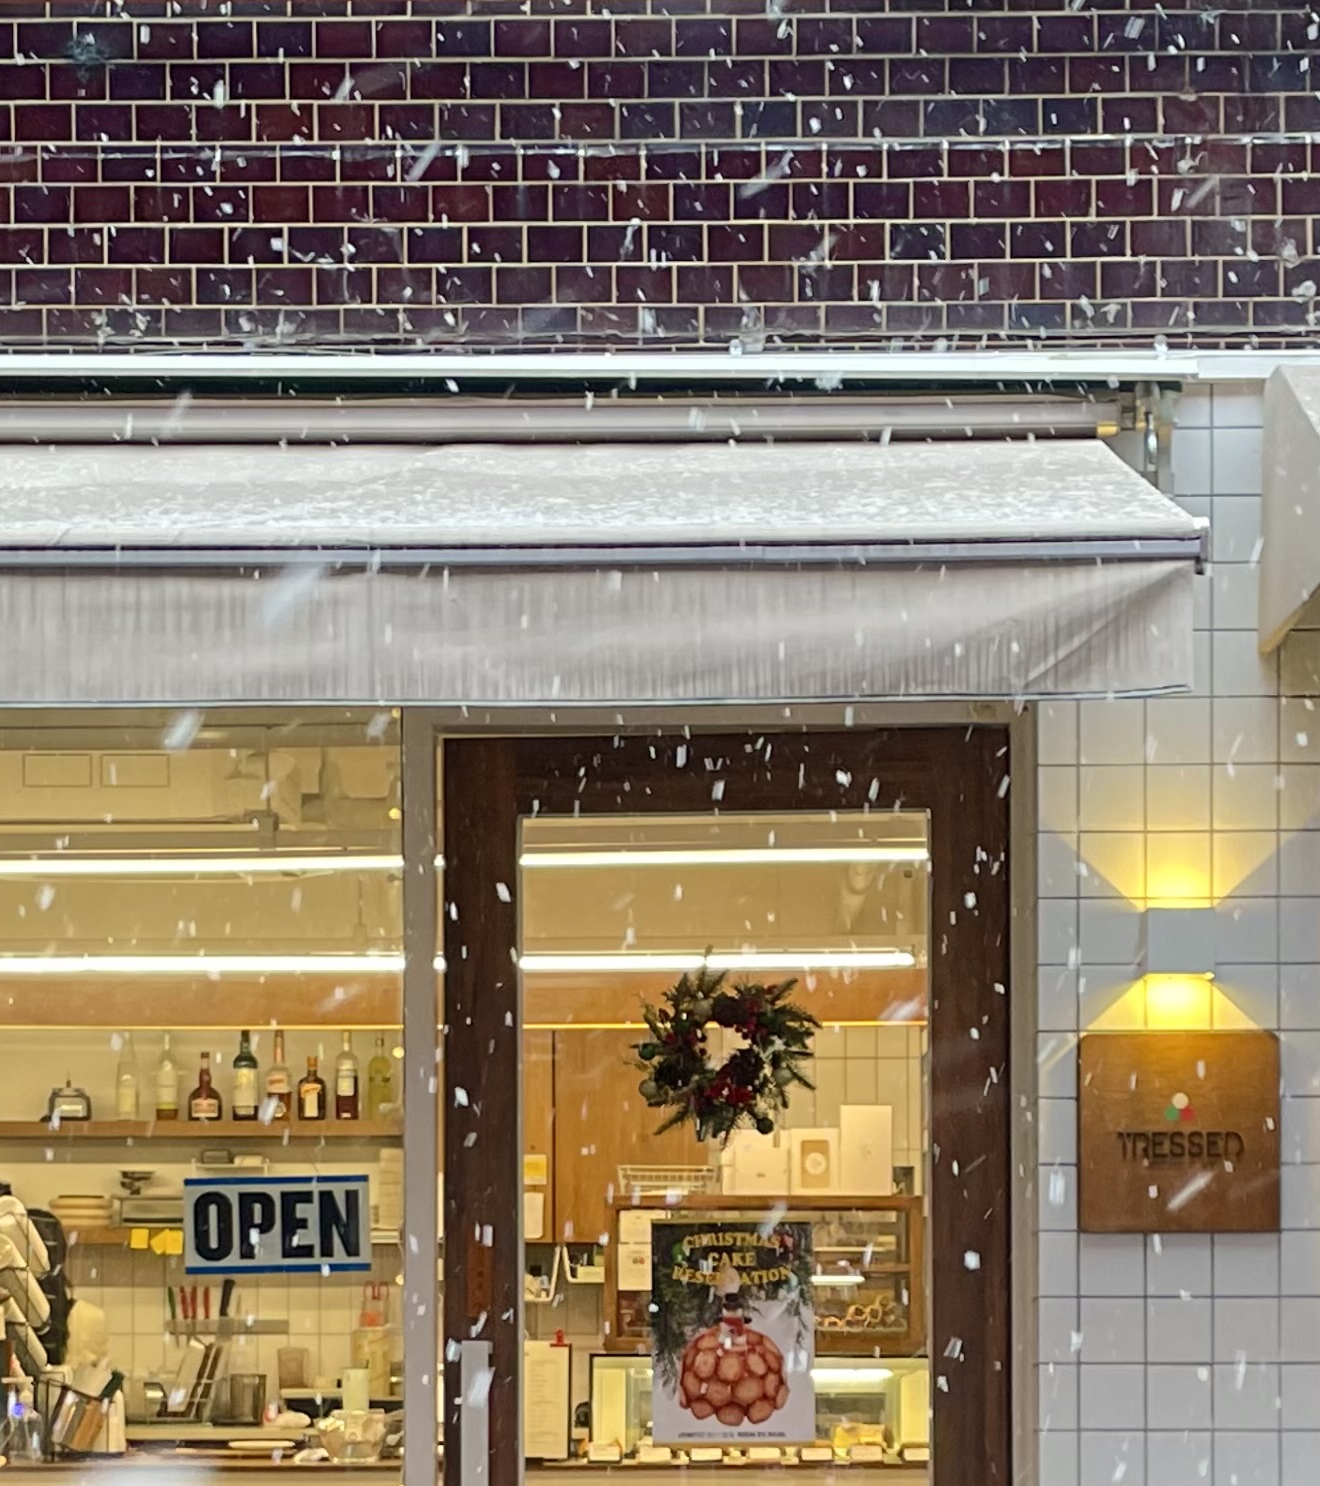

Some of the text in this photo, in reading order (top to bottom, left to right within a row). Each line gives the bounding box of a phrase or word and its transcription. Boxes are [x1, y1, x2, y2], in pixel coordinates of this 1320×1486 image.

[1116, 1131, 1245, 1160] TRESSED
[193, 1189, 361, 1262] OPEN
[683, 1232, 781, 1249] CHRISTMAS
[709, 1252, 757, 1266] CAKE
[672, 1264, 792, 1286] RESEATION
